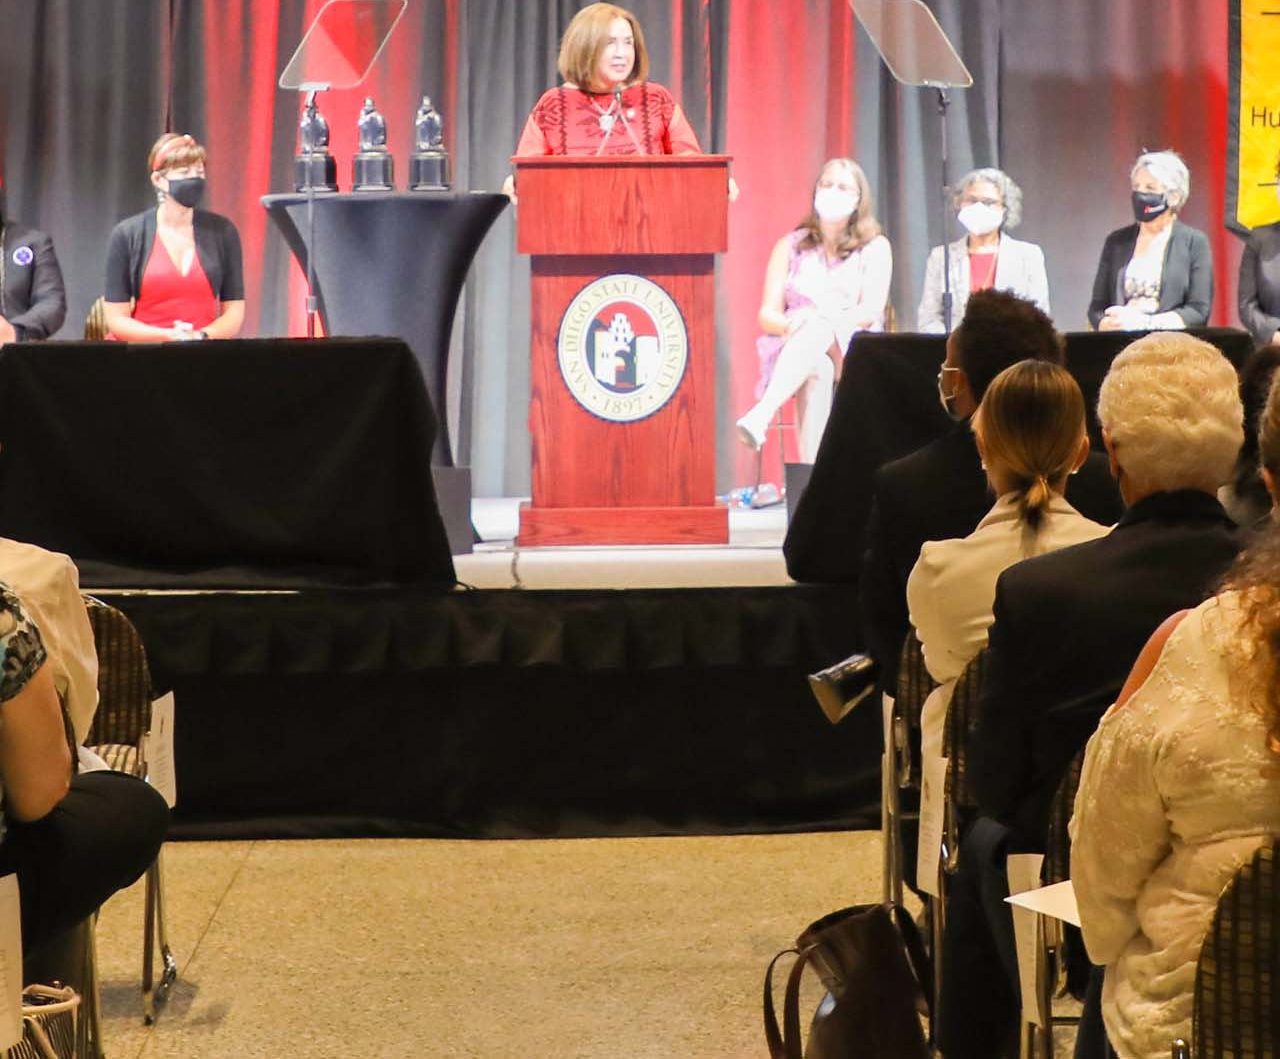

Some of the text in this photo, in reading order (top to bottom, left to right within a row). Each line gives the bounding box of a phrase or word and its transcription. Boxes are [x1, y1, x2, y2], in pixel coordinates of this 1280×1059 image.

[565, 280, 681, 393] SAN DIEGO STATE UNIVERSITY
[603, 397, 643, 414] 1897
